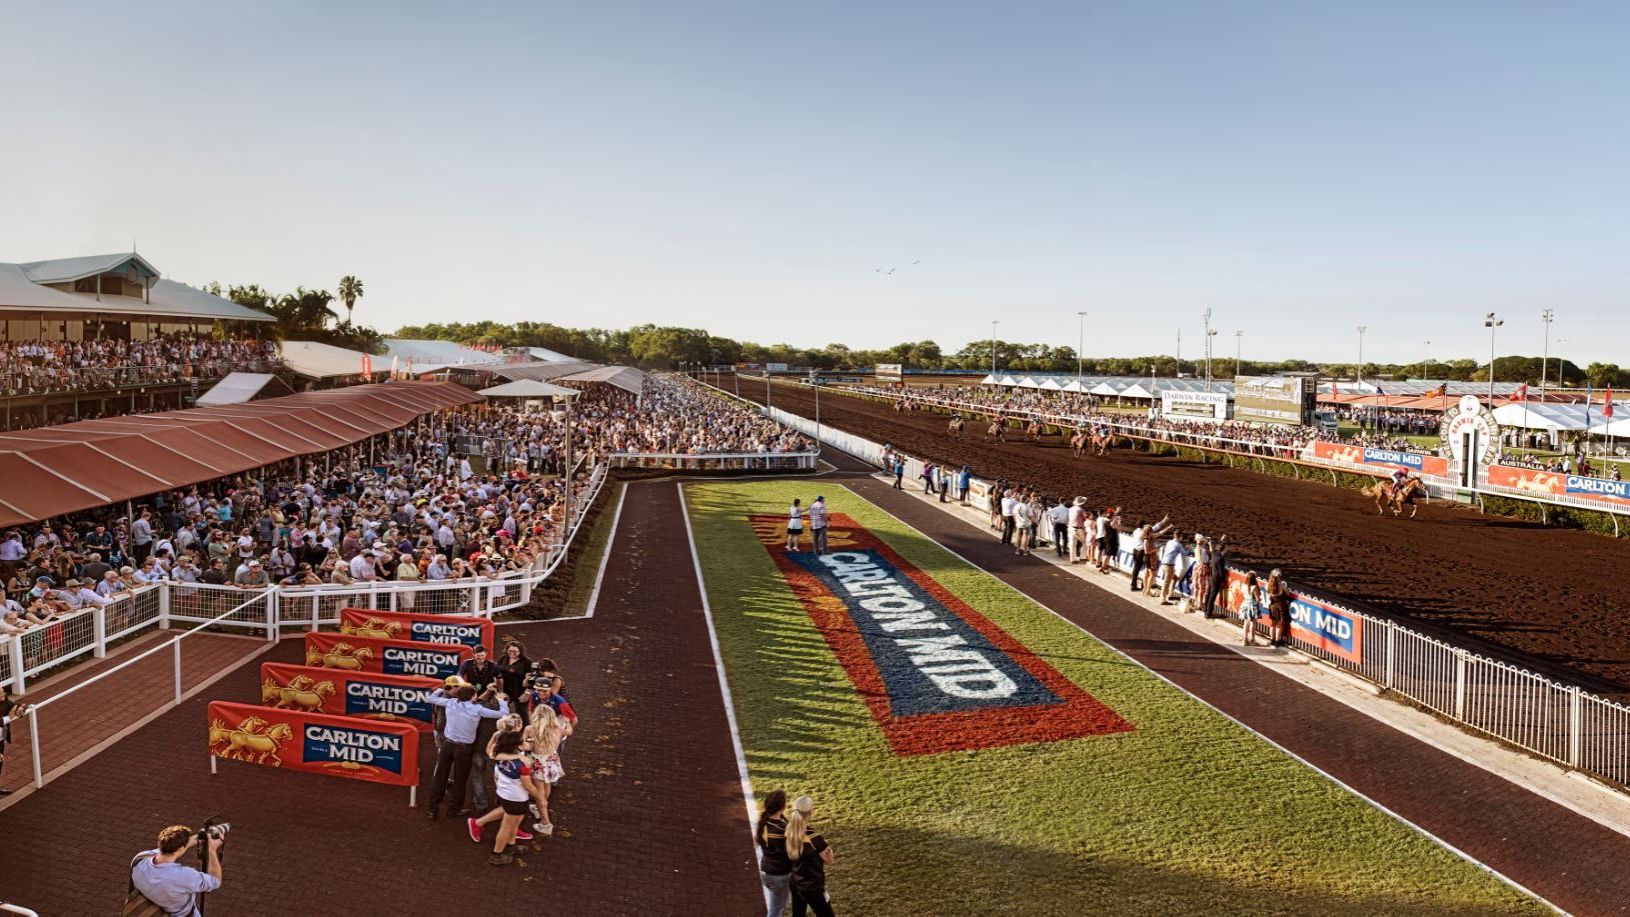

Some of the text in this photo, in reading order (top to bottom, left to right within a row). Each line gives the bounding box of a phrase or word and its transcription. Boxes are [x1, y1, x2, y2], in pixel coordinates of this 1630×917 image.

[1164, 392, 1225, 403] DARWIN RACING
[1364, 449, 1421, 465] CARLTON MID
[1499, 459, 1545, 471] AUSTRALIA
[1567, 476, 1626, 495] CARLTON
[412, 622, 481, 637] CARLTON
[818, 552, 1018, 699] CARLTON MID
[1315, 610, 1351, 640] MID
[430, 635, 461, 645] MID
[384, 649, 459, 666] CARLTON
[403, 662, 438, 675] MID
[347, 683, 431, 703] CARLTON
[368, 698, 408, 714] MID
[306, 726, 400, 751] CARLTON
[329, 744, 374, 763] MID
